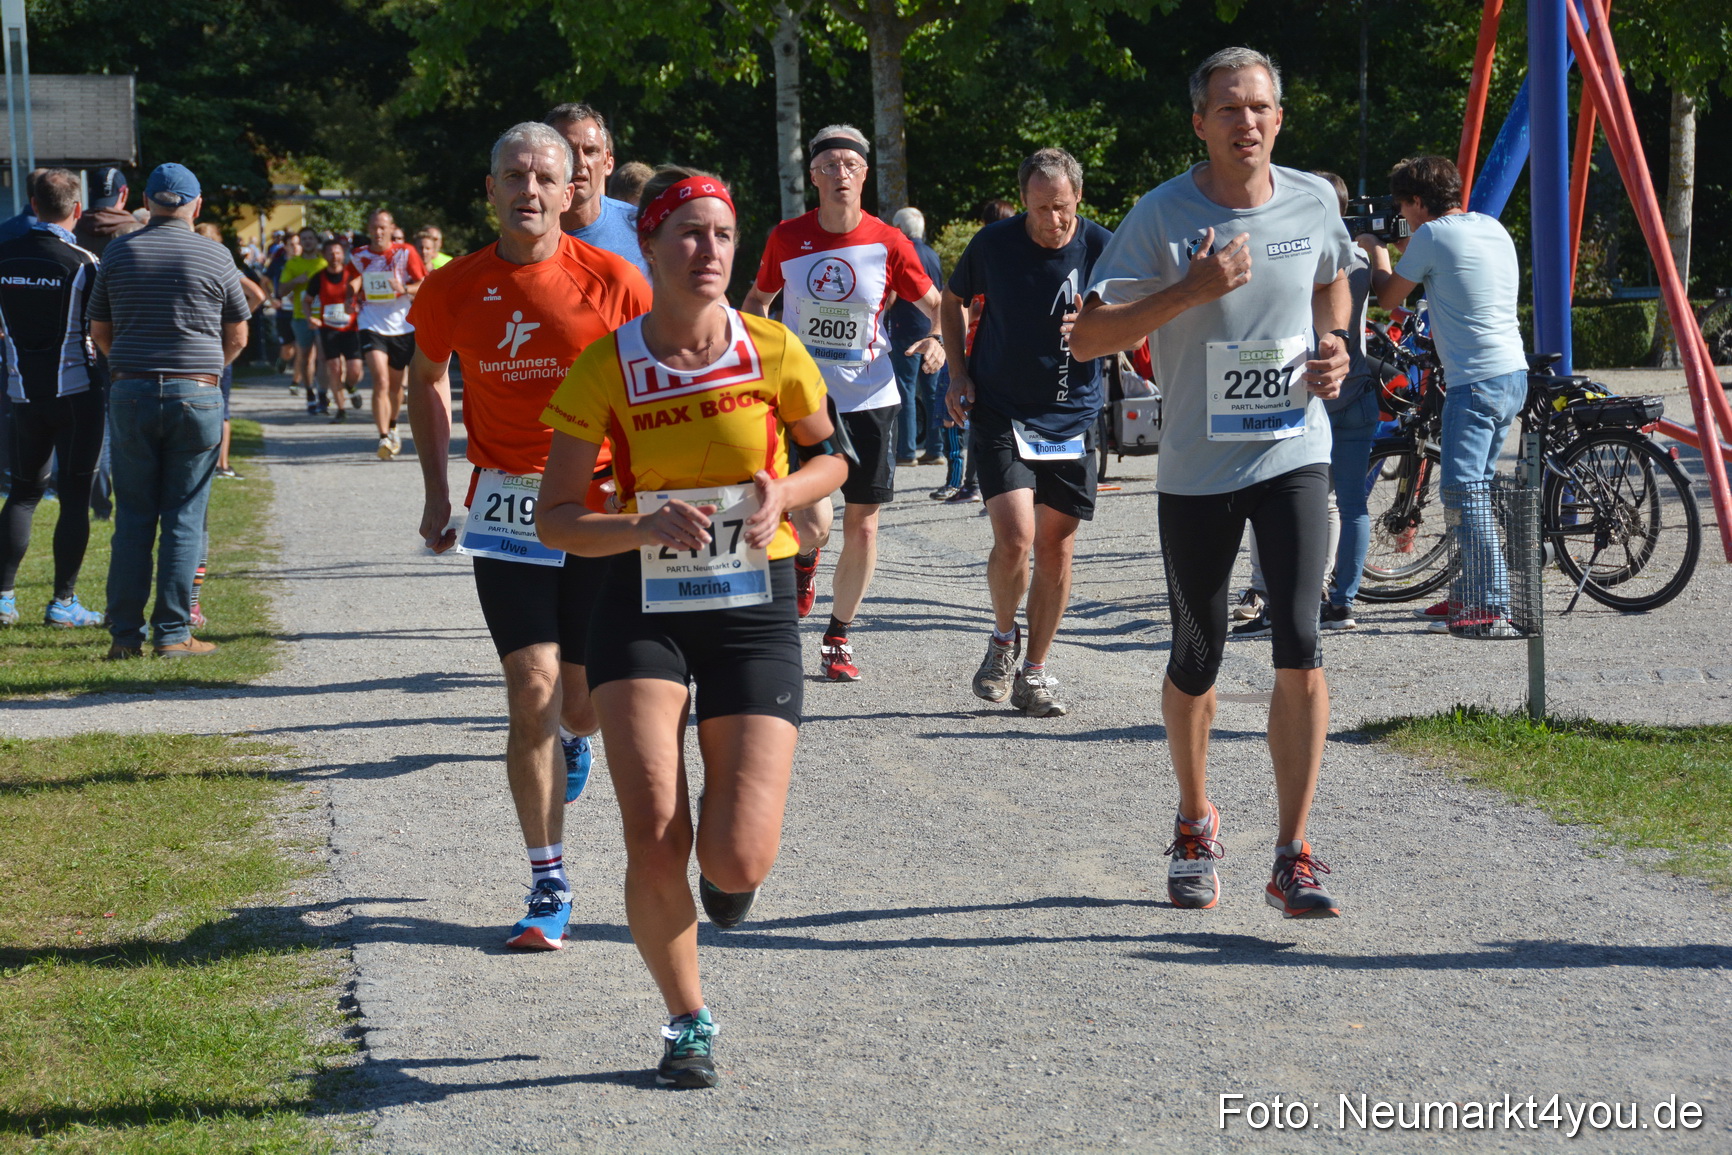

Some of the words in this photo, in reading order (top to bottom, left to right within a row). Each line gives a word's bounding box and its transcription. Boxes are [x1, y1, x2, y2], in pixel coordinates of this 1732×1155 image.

[1267, 238, 1311, 256] BOCK
[370, 281, 387, 290] 134
[819, 306, 849, 315] BOCK
[808, 317, 857, 340] 2603
[815, 348, 847, 360] Rüdiger
[1240, 349, 1284, 361] BOCK
[479, 358, 558, 374] funrunners
[502, 366, 570, 382] neumarkt
[1224, 366, 1294, 399] 2287
[631, 405, 693, 432] MAX
[699, 389, 766, 419] BÖGL
[1254, 402, 1284, 410] Neumarkt
[1242, 416, 1282, 430] Martin
[1034, 444, 1067, 453] Thomas
[503, 476, 541, 489] BOCK
[488, 526, 509, 534] PARTL
[510, 528, 537, 537] Neumark
[500, 539, 528, 555] Uwe
[666, 565, 692, 573] PARTL
[693, 562, 730, 572] Neumarkt
[678, 580, 731, 597] Marina
